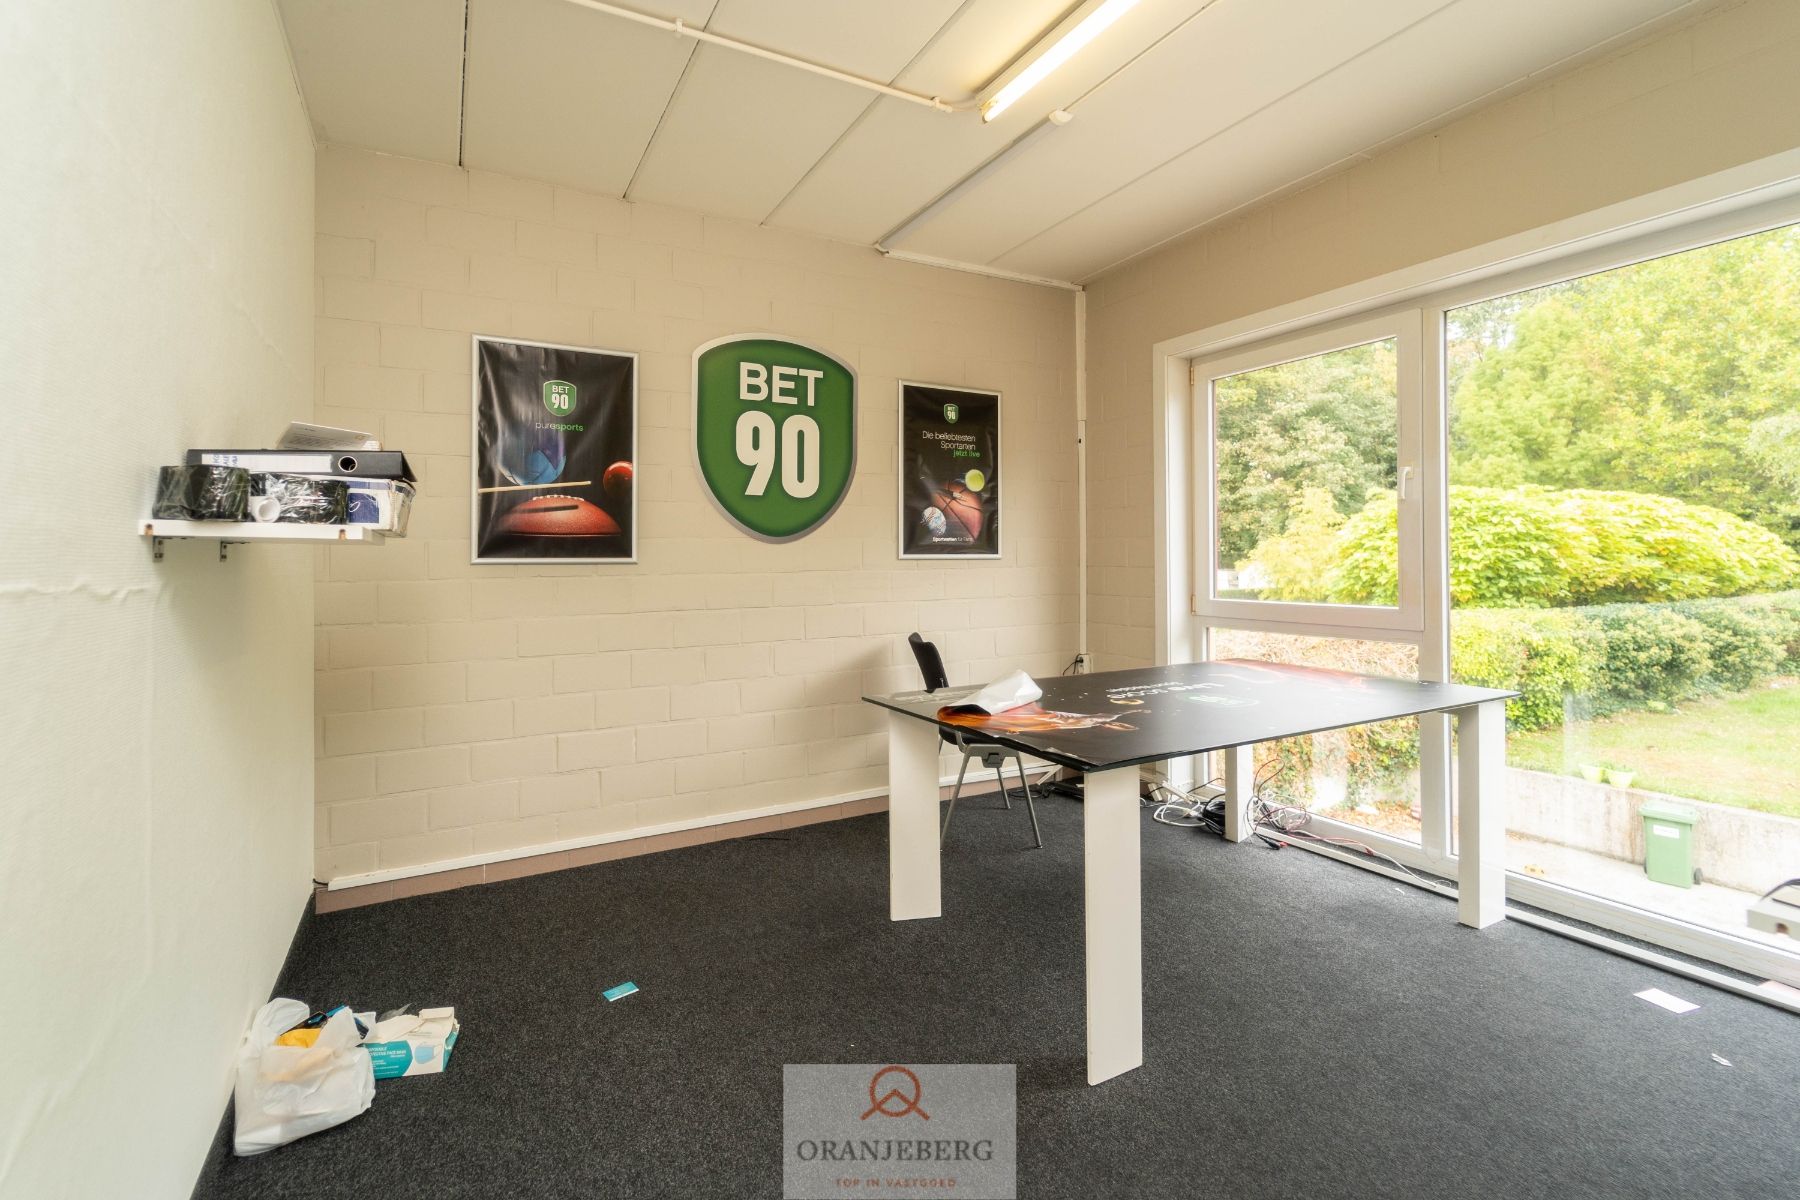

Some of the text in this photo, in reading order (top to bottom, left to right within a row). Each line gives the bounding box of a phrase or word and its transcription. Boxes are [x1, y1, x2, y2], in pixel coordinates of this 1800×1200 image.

[552, 385, 569, 393] BET
[740, 362, 823, 406] BET
[552, 393, 568, 409] 90
[535, 422, 584, 432] puresports
[922, 430, 976, 442] Die beliebtesten
[736, 411, 820, 498] 90
